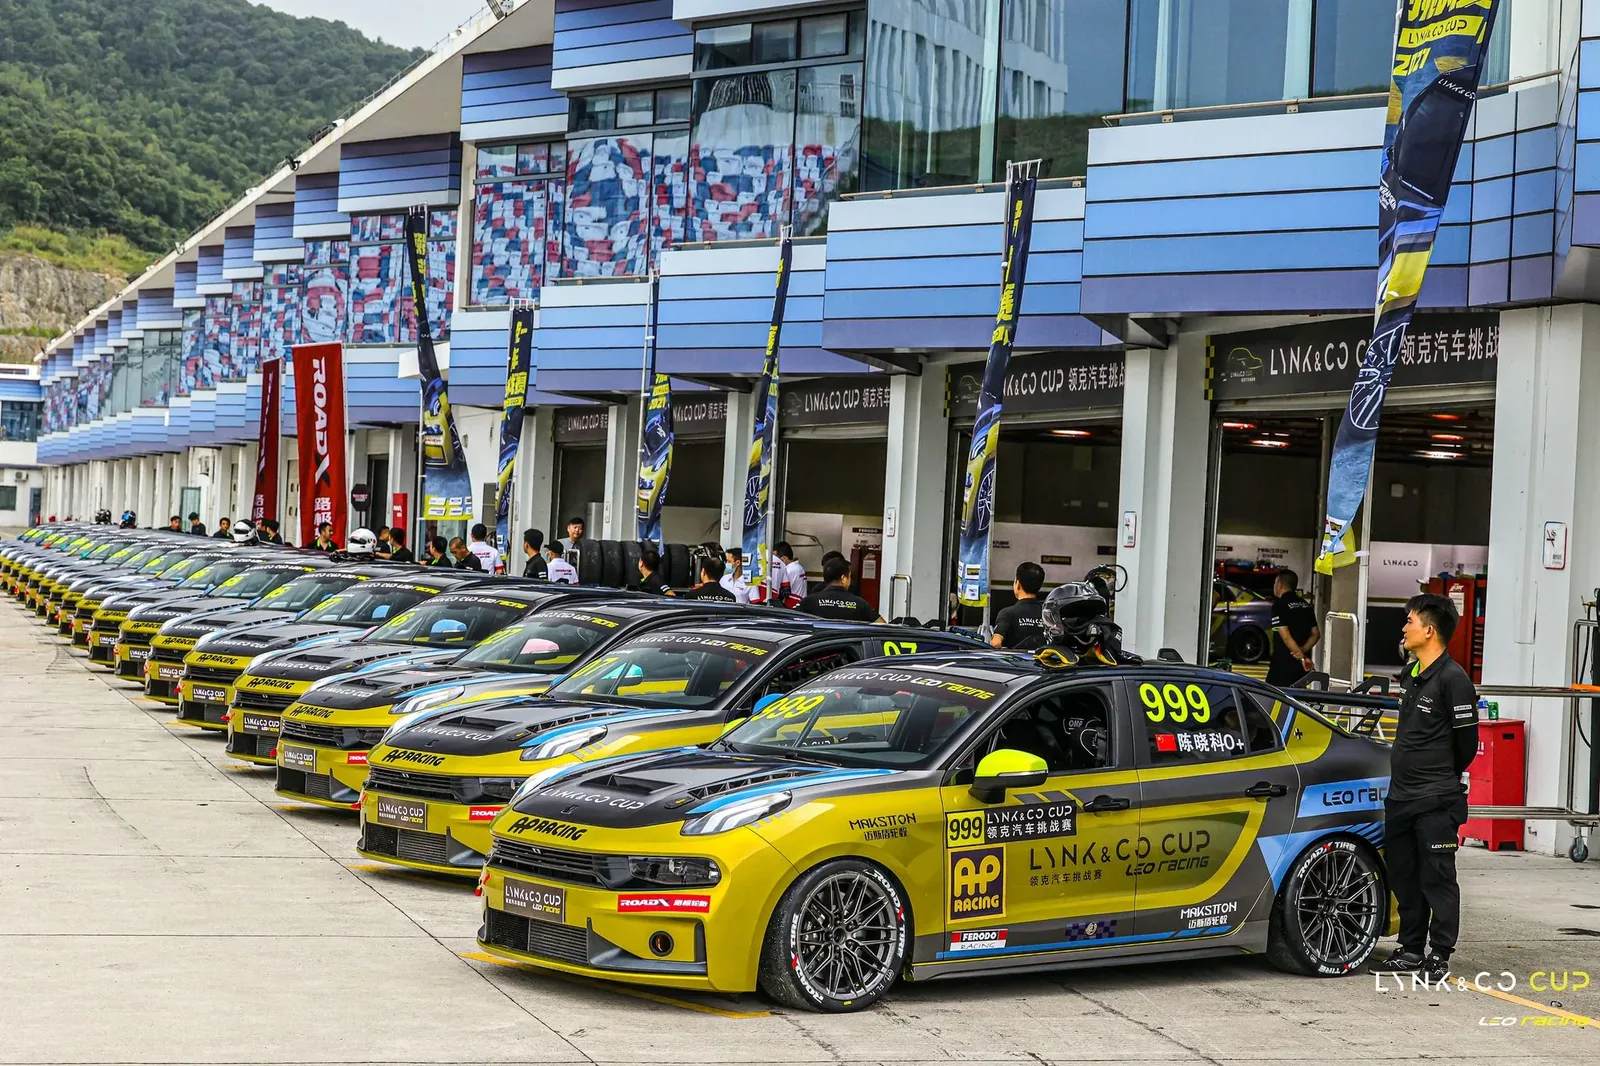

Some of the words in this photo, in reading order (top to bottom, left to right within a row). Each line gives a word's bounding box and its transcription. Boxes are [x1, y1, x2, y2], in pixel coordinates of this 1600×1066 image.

[1444, 19, 1468, 33] CUP
[1270, 342, 1349, 376] LYNK&CO
[1041, 368, 1064, 392] CUP
[804, 391, 840, 412] LYNK&CO
[843, 389, 860, 408] CUP
[694, 403, 706, 420] CUP
[312, 356, 330, 488] ROADX
[1383, 559, 1418, 567] LYNK&CO
[674, 634, 700, 644] CUP
[701, 638, 726, 648] LEO
[722, 641, 768, 656] racing
[210, 655, 238, 664] RACING
[262, 679, 294, 690] RACING
[880, 672, 910, 682] CUP
[910, 676, 942, 688] LEO
[938, 681, 996, 700] racing
[304, 707, 334, 718] RACING
[750, 695, 826, 722] 999
[1138, 682, 1211, 724] 999
[268, 720, 279, 728] CUP
[1068, 718, 1084, 728] OMP
[467, 733, 493, 742] CUP
[382, 749, 408, 763] AP
[405, 752, 446, 767] RACING
[540, 788, 609, 804] LYNK&CO
[608, 798, 645, 810] CUP
[1322, 790, 1354, 806] LEO
[379, 802, 408, 815] LYNK&CO
[409, 808, 424, 818] CUP
[986, 808, 1044, 824] LYNK&CO
[1048, 804, 1073, 818] CUP
[508, 816, 538, 834] AP
[536, 821, 588, 841] RACING
[950, 817, 983, 842] 999
[986, 819, 1072, 839] 领克汽车挑战赛
[1030, 836, 1151, 871] LYNK&CO
[1162, 830, 1211, 856] CUP
[1297, 842, 1333, 878] ROADX
[1334, 842, 1357, 851] TIRE
[954, 854, 1000, 898] AP
[1125, 862, 1155, 876] LEO
[1158, 856, 1210, 875] racing
[1030, 870, 1102, 887] 领克汽车挑战赛
[505, 885, 541, 903] LYNK&CO
[544, 892, 561, 908] CUP
[620, 898, 670, 907] ROADX
[954, 895, 1000, 913] RACING
[542, 904, 561, 915] racing
[872, 868, 906, 922] ROADX
[896, 926, 906, 958] TIRE
[790, 913, 799, 948] TIRE
[962, 931, 998, 942] FERODO
[960, 942, 995, 950] RACING
[791, 951, 824, 1004] ROADX
[1318, 966, 1342, 974] TIRE
